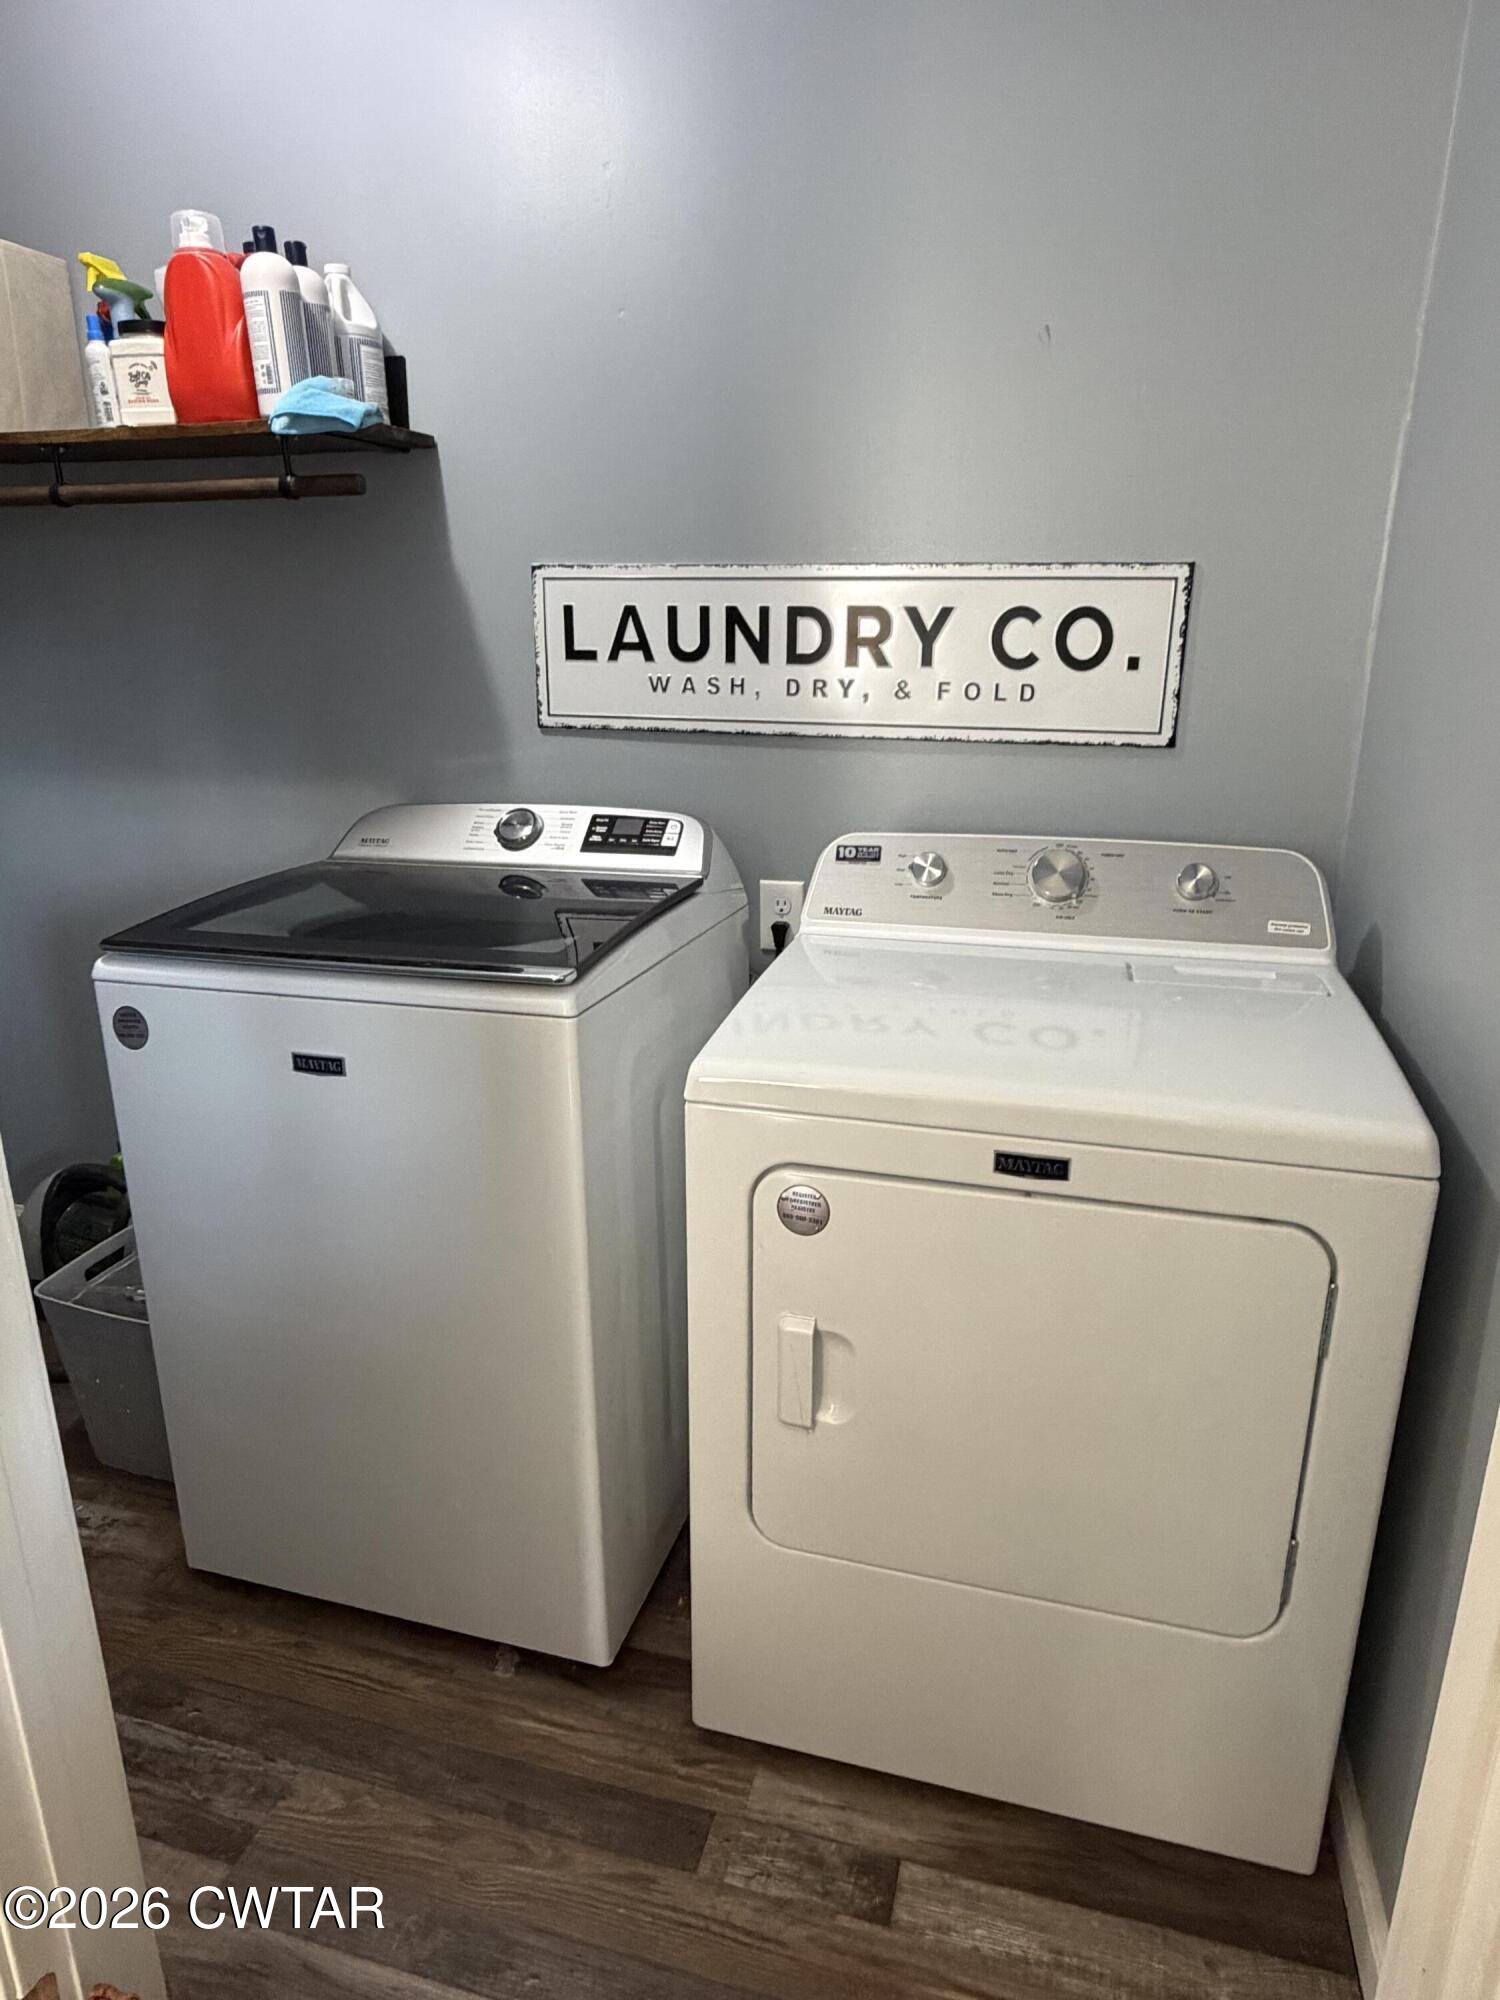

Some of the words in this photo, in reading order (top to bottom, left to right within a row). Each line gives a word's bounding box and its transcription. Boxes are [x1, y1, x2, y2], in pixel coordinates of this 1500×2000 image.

[563, 602, 954, 670] LAUNDRY
[990, 604, 1141, 671] CO.
[649, 674, 762, 702] WASH,
[786, 676, 870, 703] DRY,
[894, 680, 912, 701] &
[937, 681, 1038, 703] FOLD
[838, 846, 857, 860] 10
[823, 906, 863, 917] MAYTAG
[295, 1058, 342, 1073] MAYTAG
[998, 1156, 1065, 1175] MAYTAG
